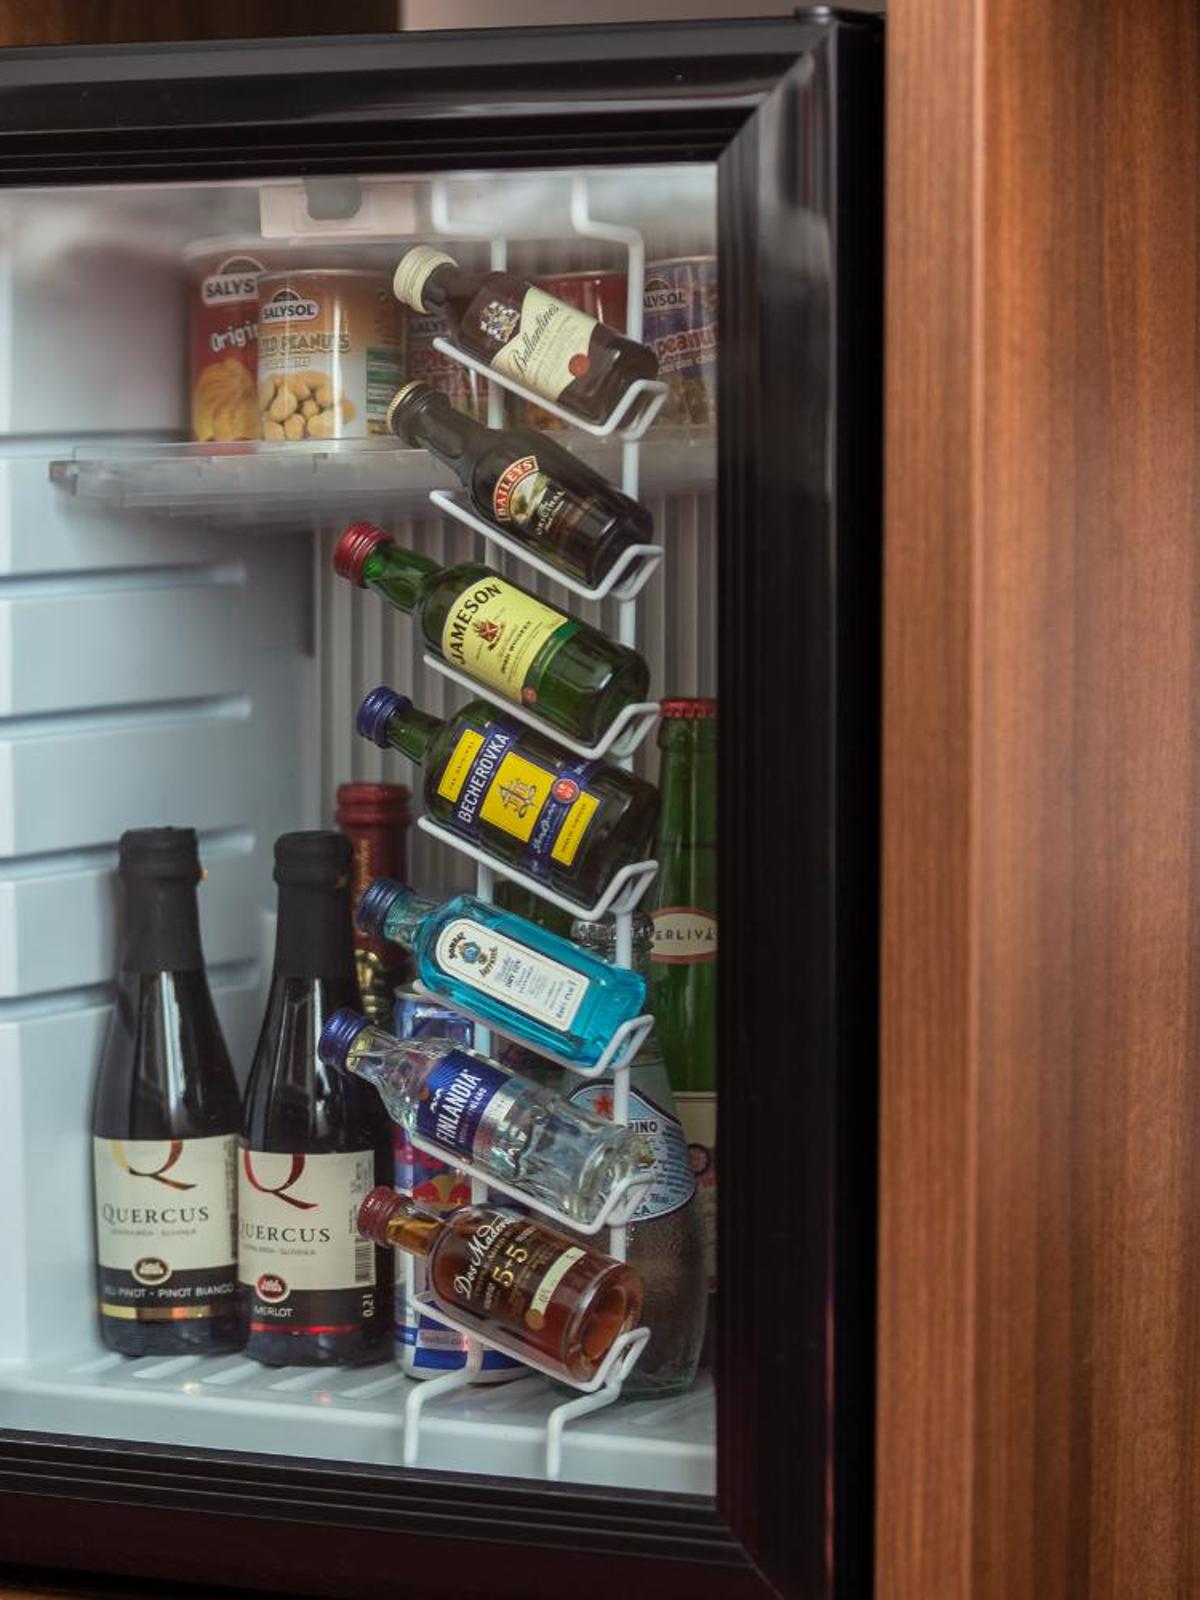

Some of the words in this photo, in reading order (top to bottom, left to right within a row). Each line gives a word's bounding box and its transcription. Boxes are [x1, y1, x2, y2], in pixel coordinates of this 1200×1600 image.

[496, 459, 533, 517] BAILEYS
[450, 584, 502, 666] JAMESON
[457, 732, 511, 824] BECHEROVKA
[436, 1071, 483, 1146] FINLANDIA
[103, 1202, 209, 1226] QUERCUS
[241, 1222, 331, 1243] UERCUS
[157, 1287, 193, 1299] PINOT
[253, 1304, 295, 1318] MERLOT
